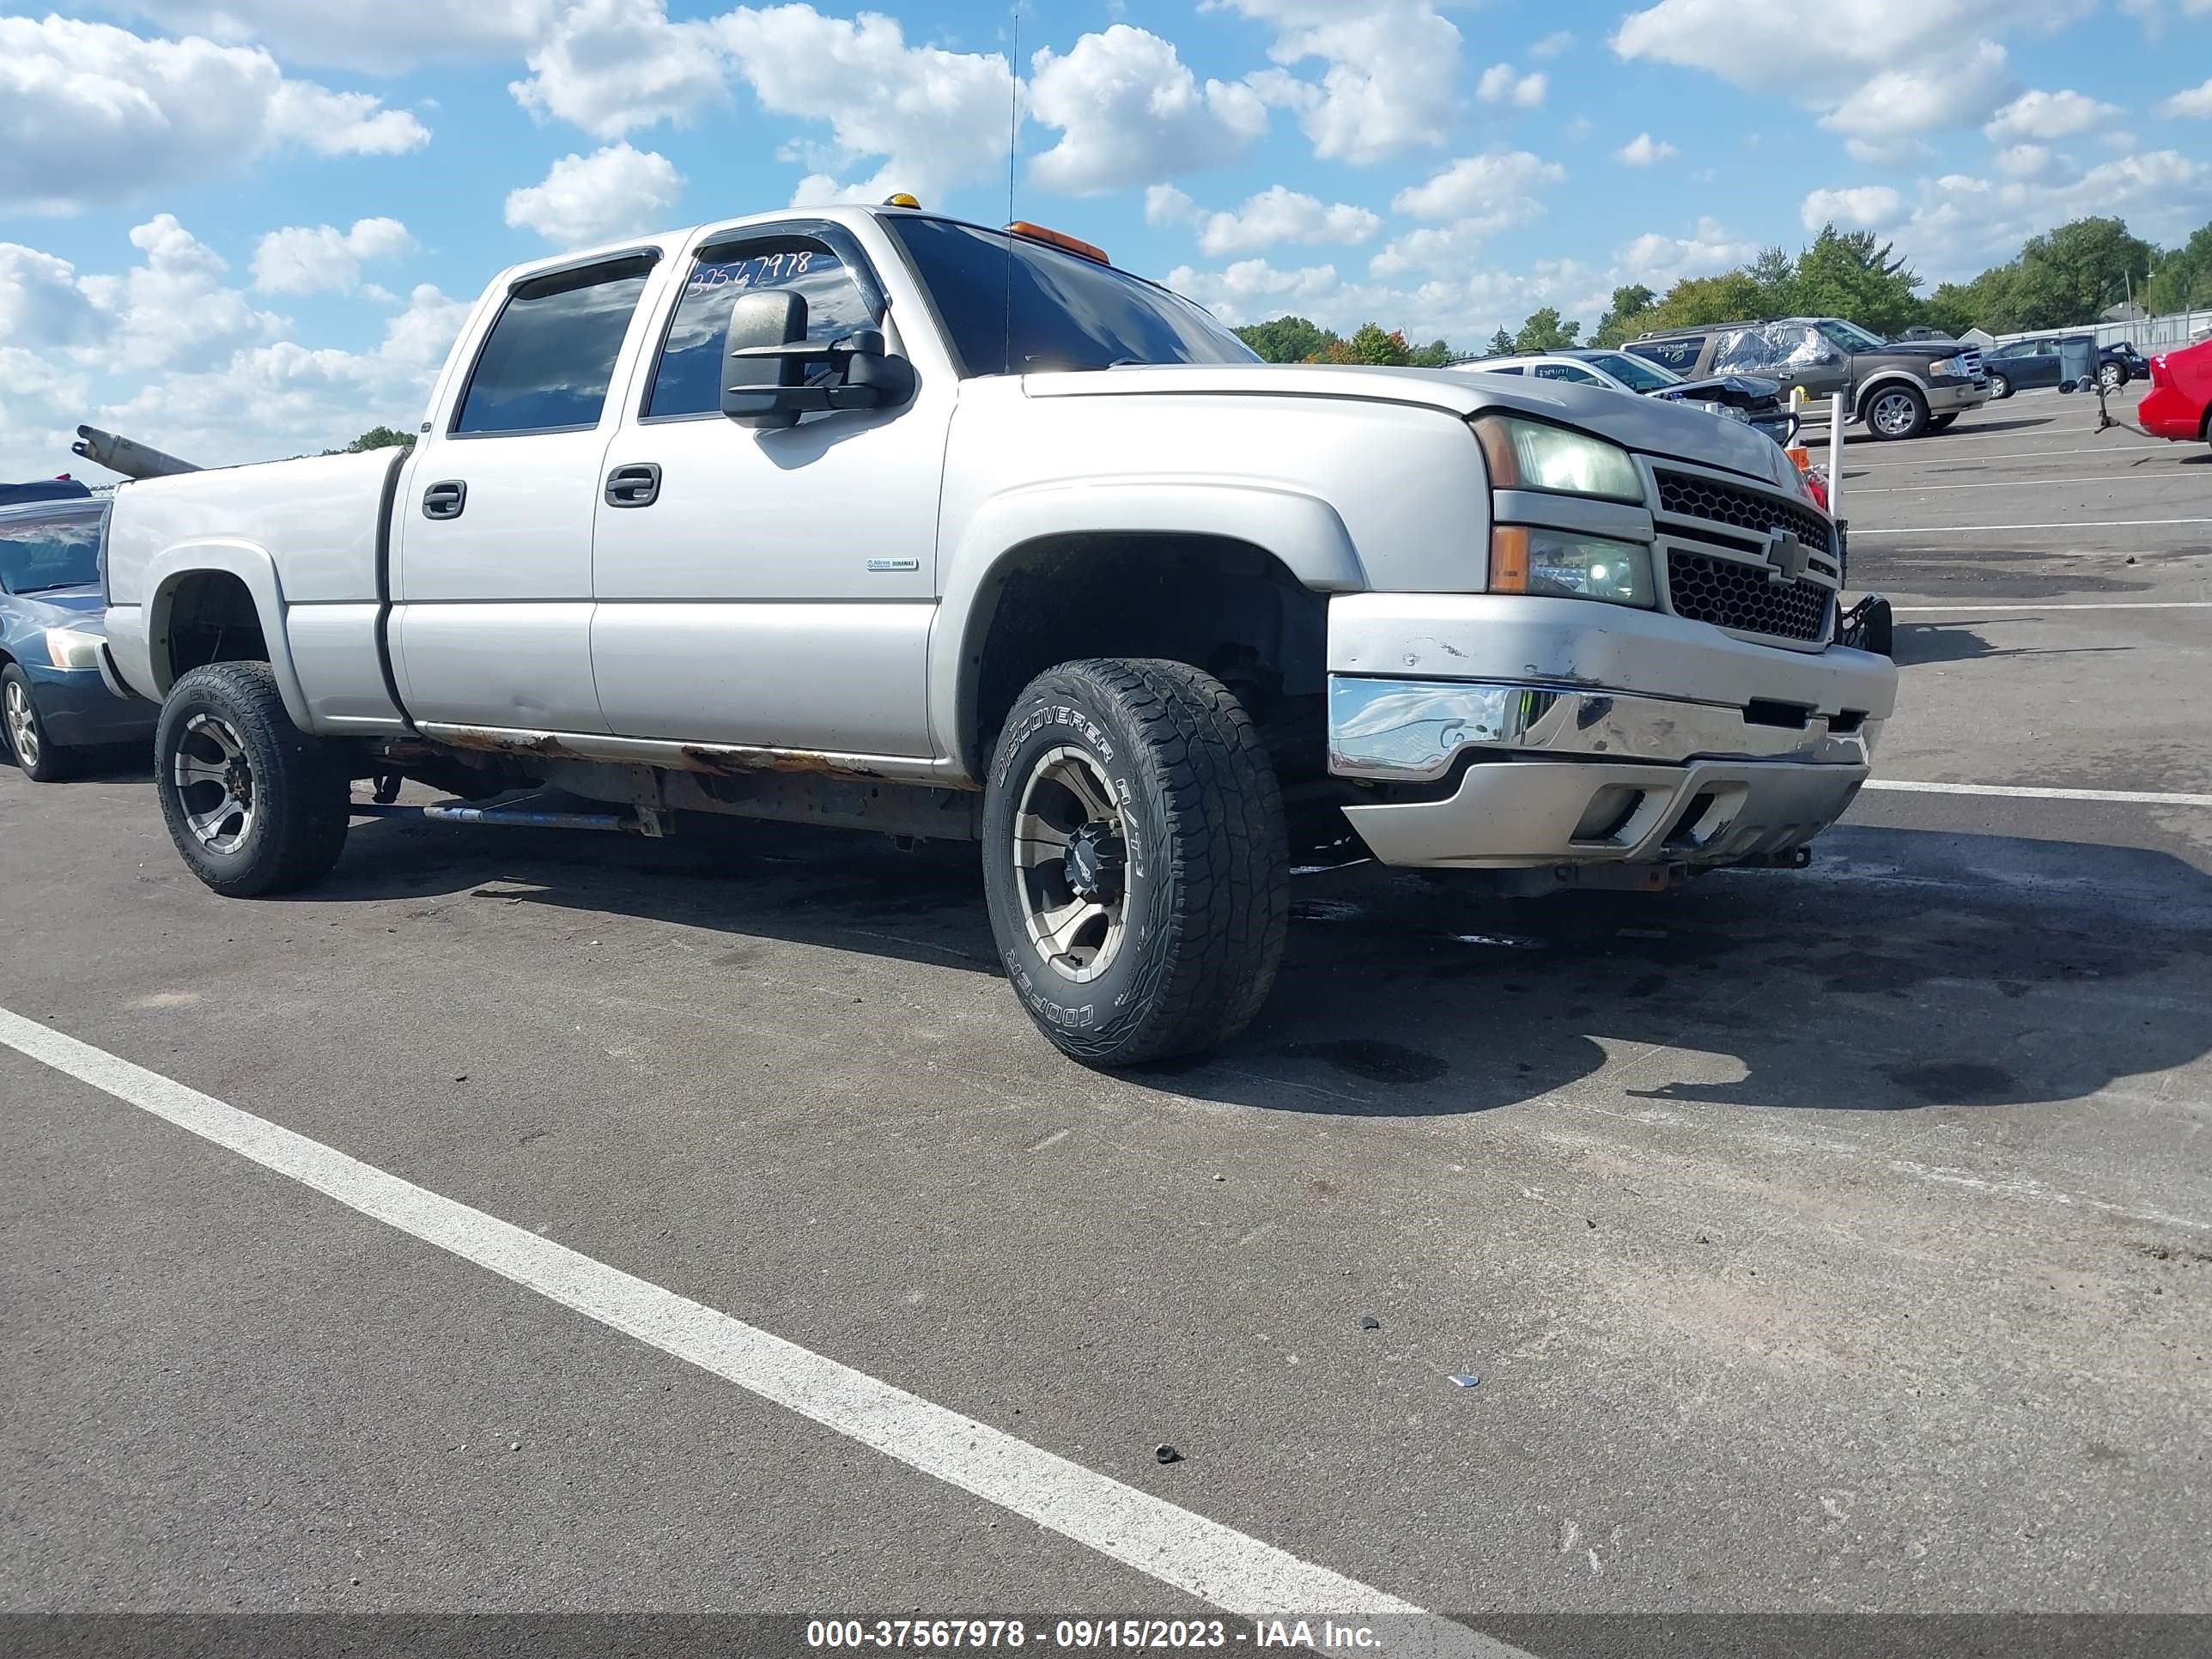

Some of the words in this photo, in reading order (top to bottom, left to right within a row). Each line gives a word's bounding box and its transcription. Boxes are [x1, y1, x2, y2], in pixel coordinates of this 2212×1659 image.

[688, 251, 813, 297] 37567978
[996, 705, 1115, 788] DISCOVERER
[1000, 947, 1095, 1028] COOPER
